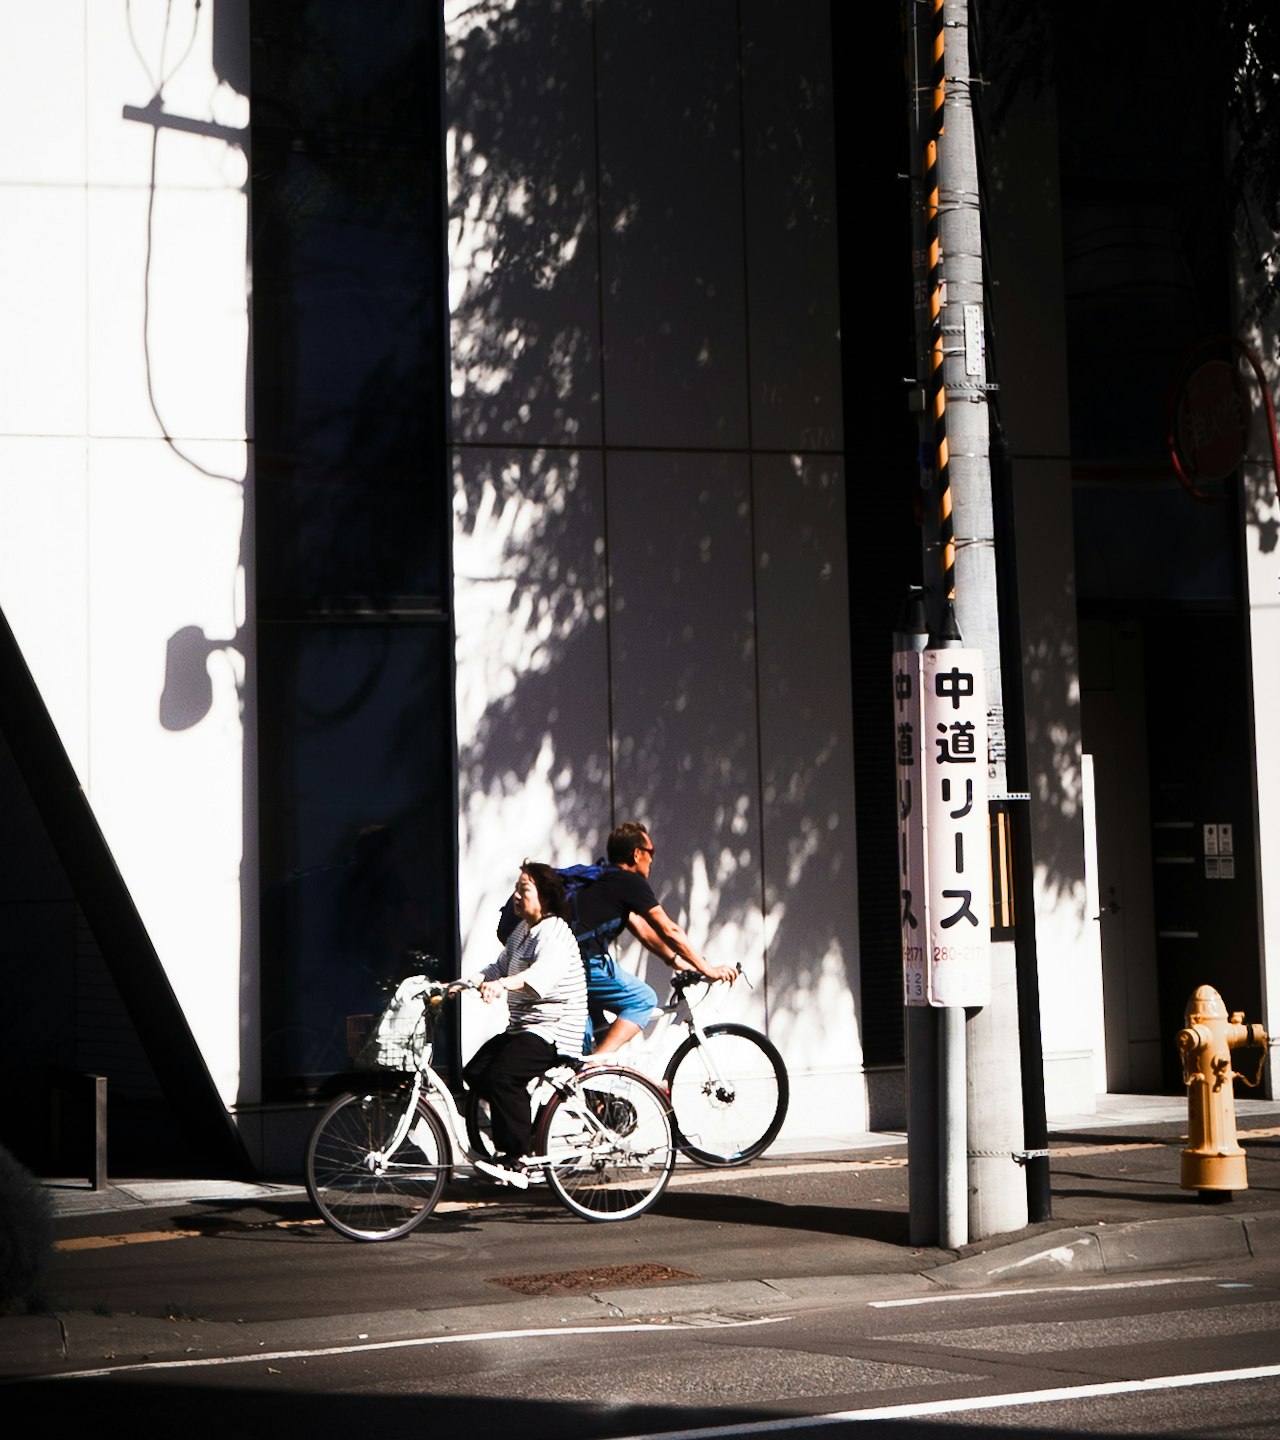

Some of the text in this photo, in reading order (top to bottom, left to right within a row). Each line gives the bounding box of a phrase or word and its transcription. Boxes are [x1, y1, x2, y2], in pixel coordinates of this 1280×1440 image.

[935, 667, 978, 928] 中道リース
[933, 946, 984, 961] 280-217
